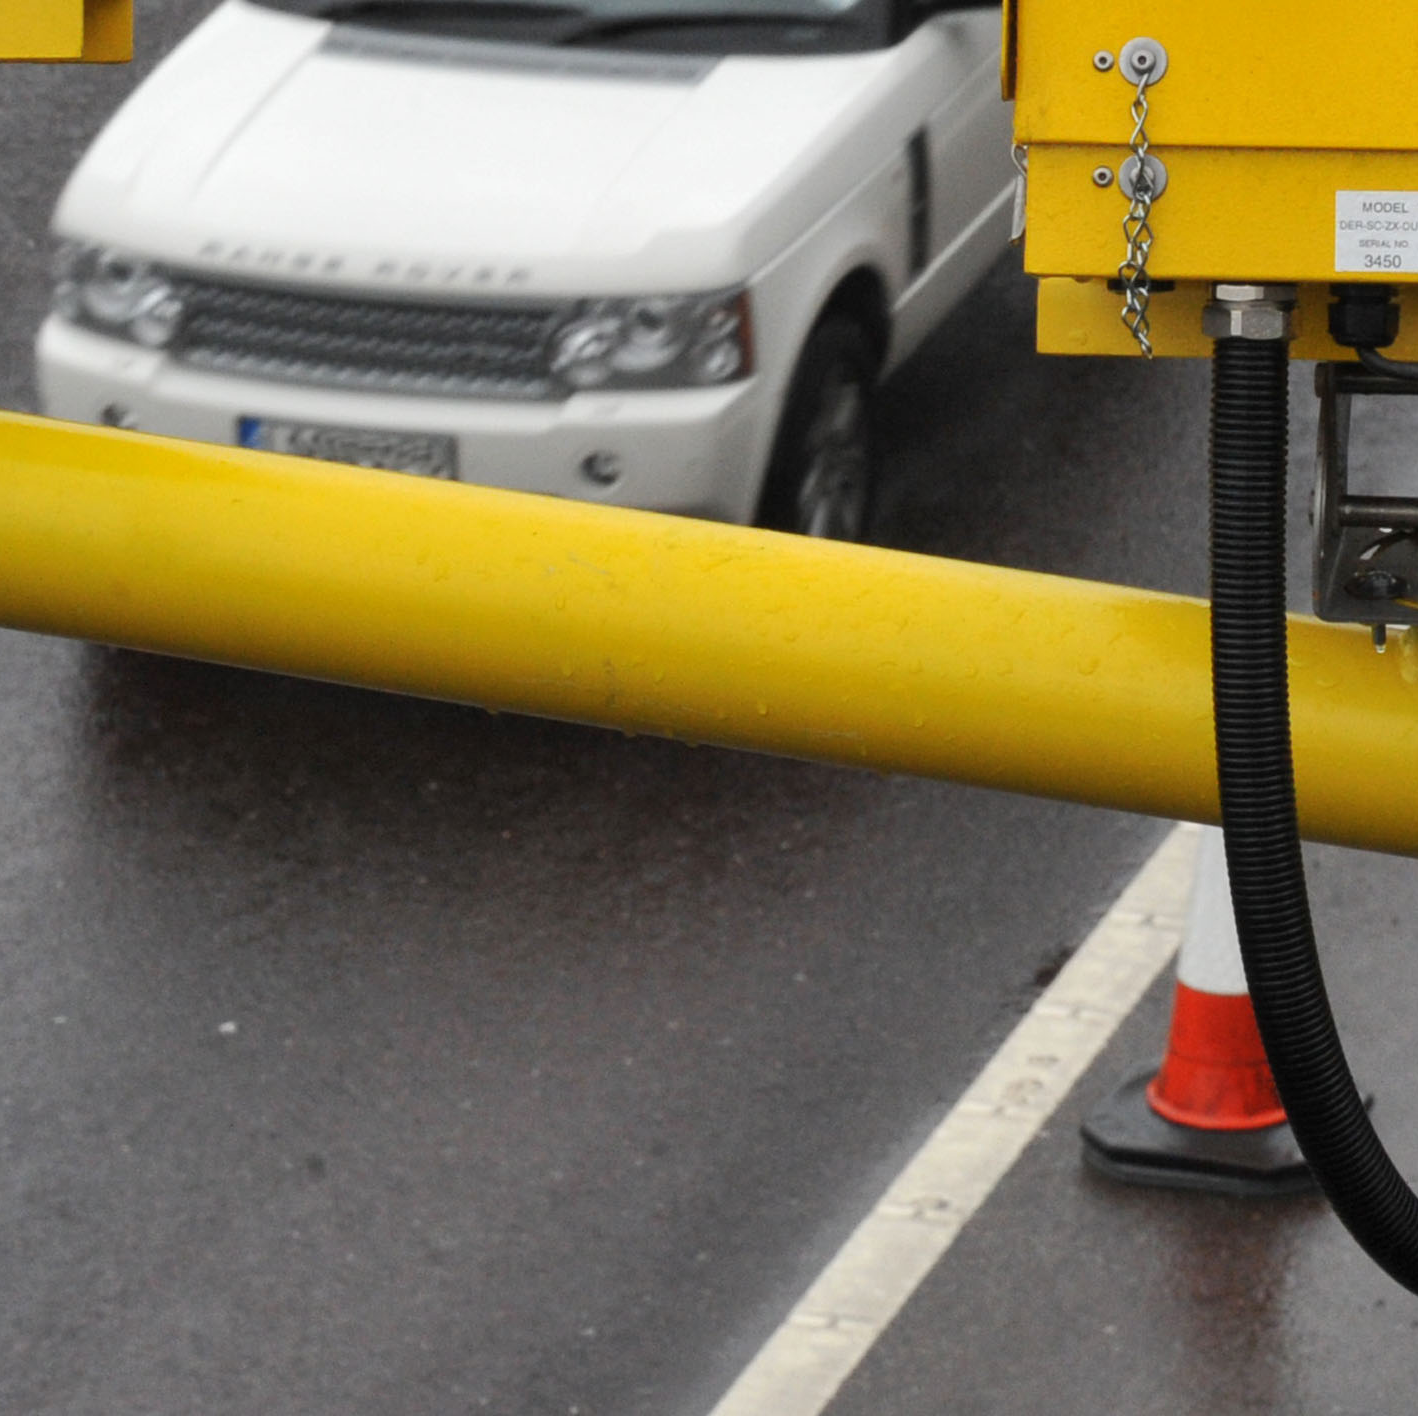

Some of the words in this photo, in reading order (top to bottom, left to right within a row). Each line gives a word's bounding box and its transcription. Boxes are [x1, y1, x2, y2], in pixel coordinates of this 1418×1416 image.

[1362, 202, 1409, 213] MODEL
[1359, 239, 1391, 248] SERIAL
[1364, 253, 1402, 269] 3450
